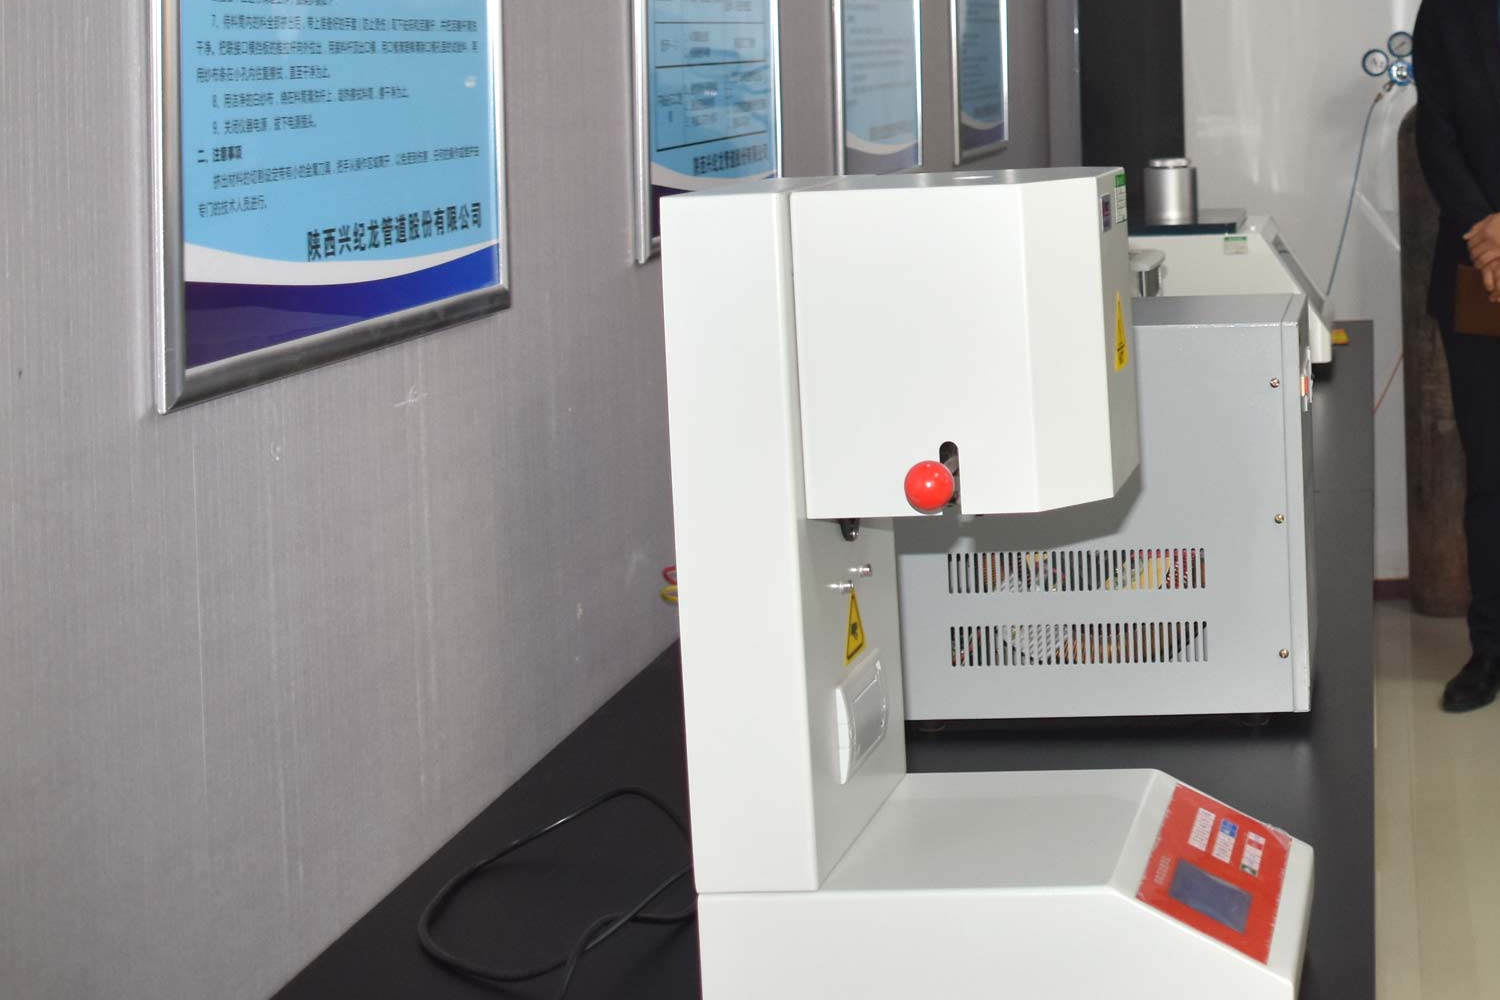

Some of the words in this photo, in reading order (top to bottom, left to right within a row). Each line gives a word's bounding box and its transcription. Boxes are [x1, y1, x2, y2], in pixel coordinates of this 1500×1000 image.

[307, 202, 481, 264] 陕西兴纪龙管道股份有限公司
